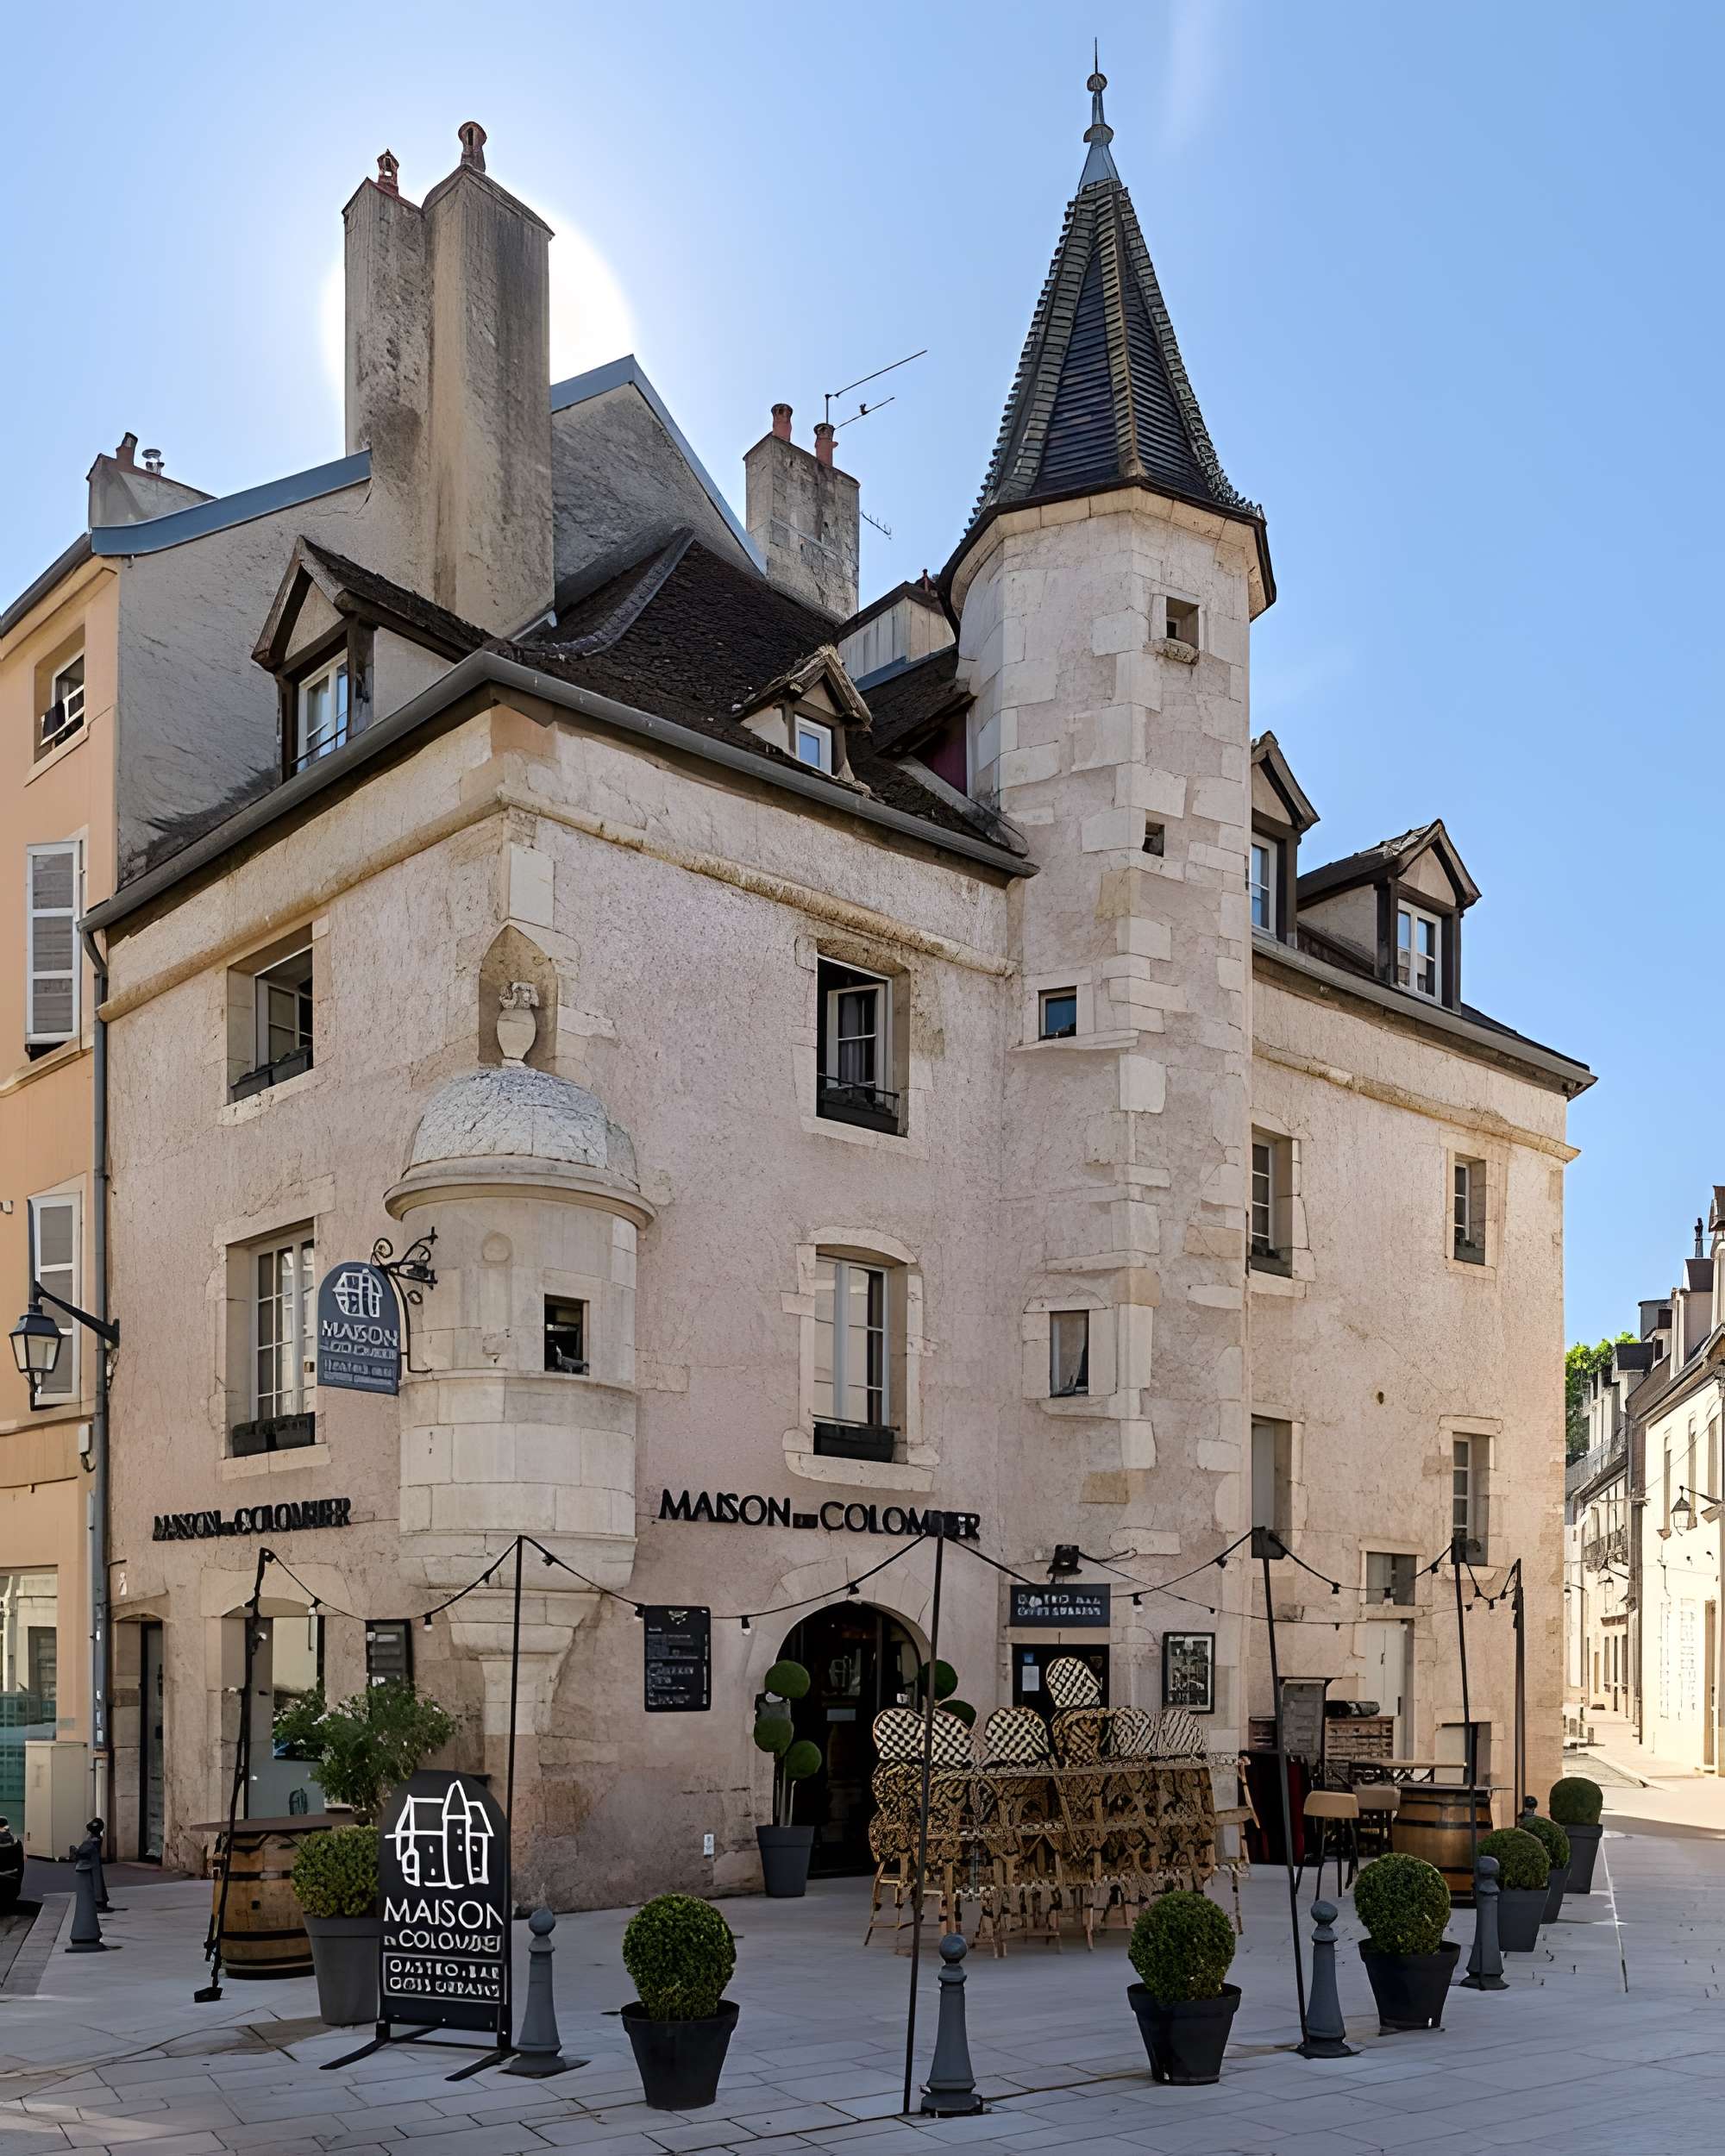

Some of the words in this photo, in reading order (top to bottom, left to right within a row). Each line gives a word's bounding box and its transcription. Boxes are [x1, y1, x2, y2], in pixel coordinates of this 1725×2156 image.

[659, 1489, 790, 1527] MAISON
[819, 1501, 980, 1539] COLOMER
[383, 1896, 505, 1929] MAISON
